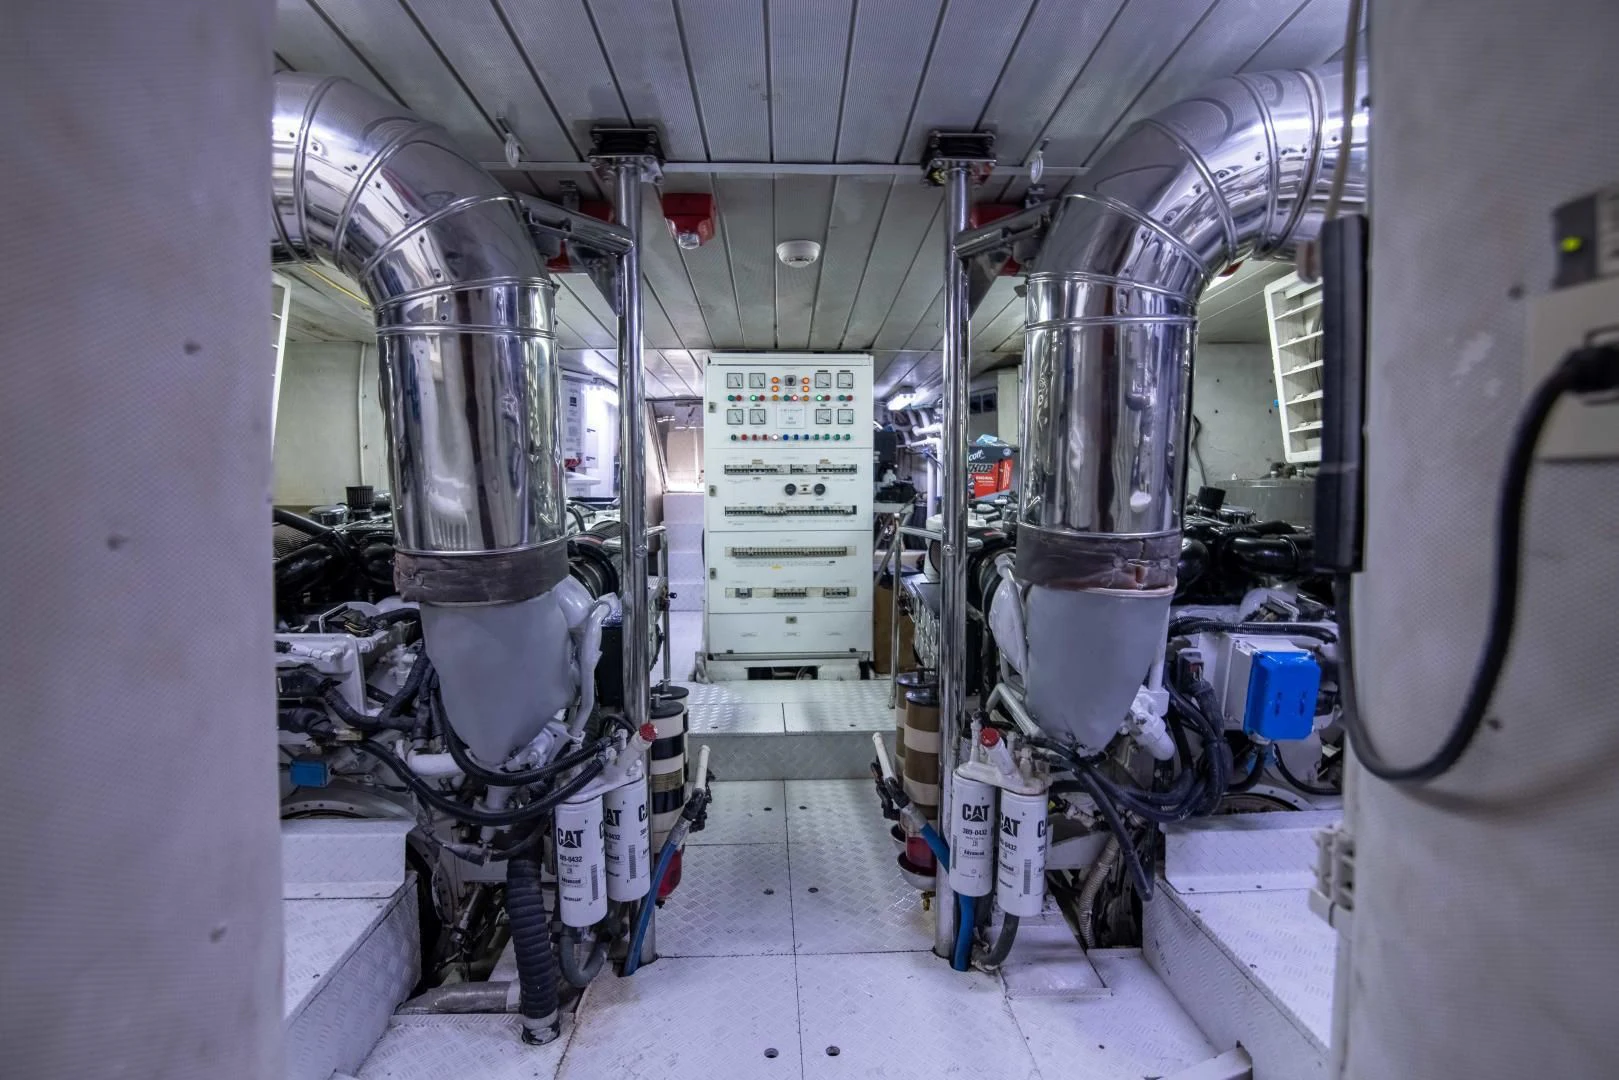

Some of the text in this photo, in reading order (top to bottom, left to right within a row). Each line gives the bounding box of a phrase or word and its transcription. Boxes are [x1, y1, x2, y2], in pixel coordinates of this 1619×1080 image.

[968, 449, 983, 461] cott
[968, 463, 993, 473] HOP
[604, 808, 622, 827] AT
[962, 804, 990, 822] CAT
[557, 827, 583, 848] CAT
